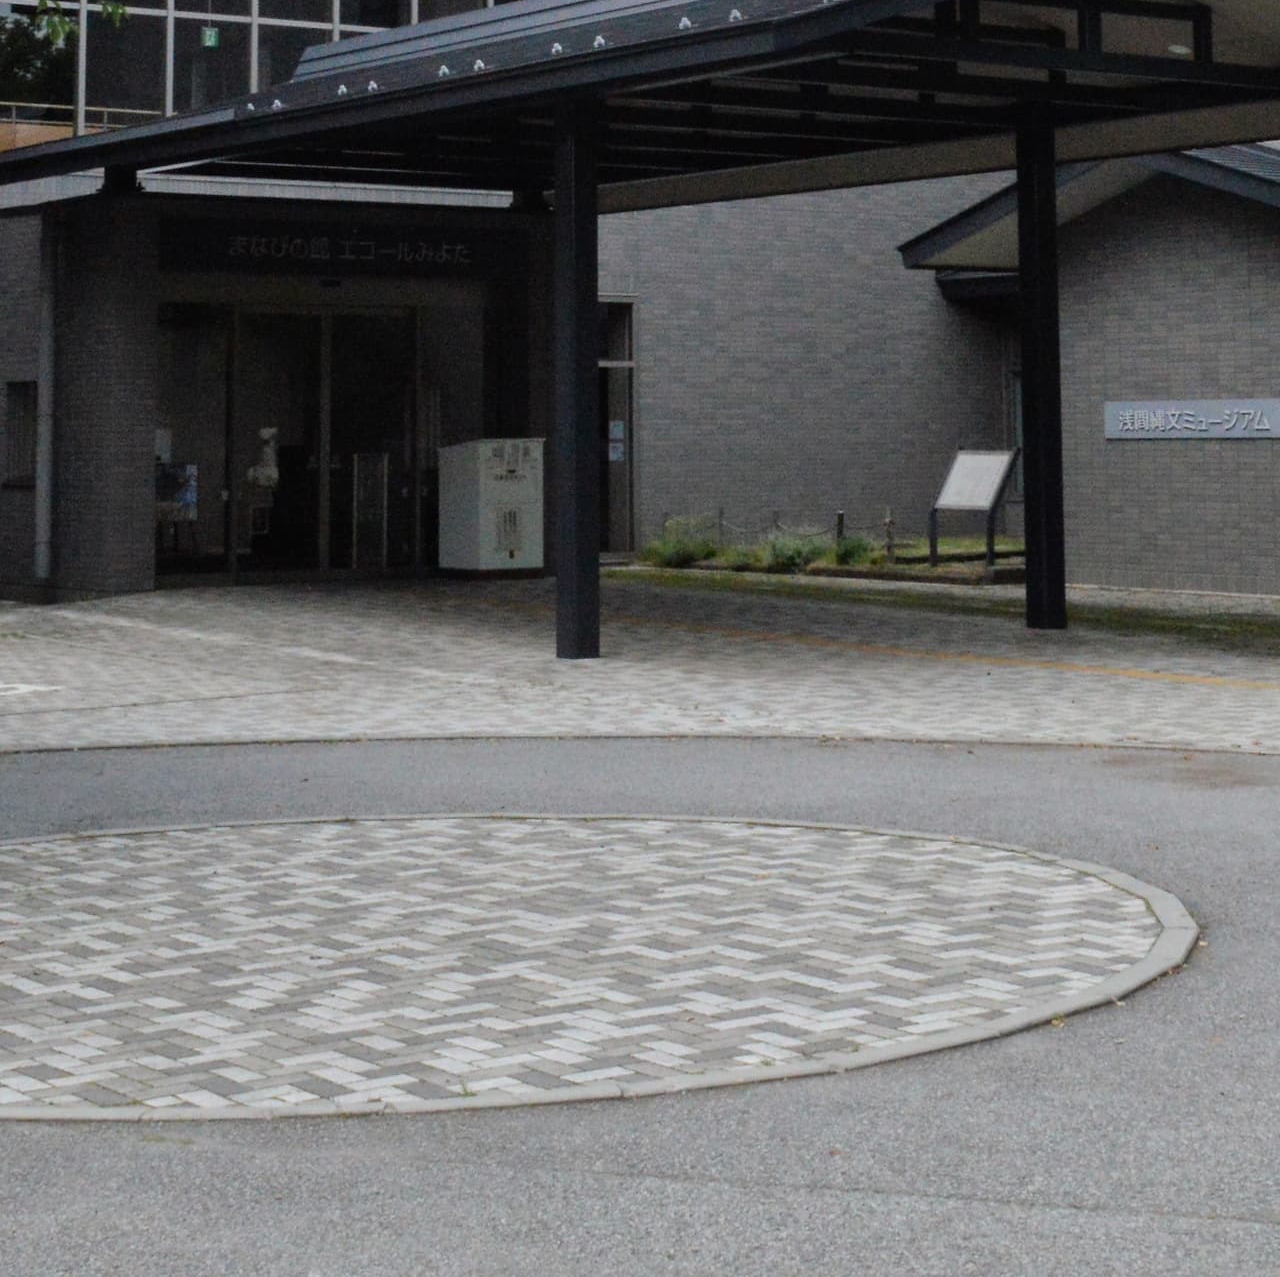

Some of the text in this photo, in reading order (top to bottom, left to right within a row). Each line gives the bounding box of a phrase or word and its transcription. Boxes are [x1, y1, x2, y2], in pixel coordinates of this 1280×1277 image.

[228, 234, 473, 265] まなびの館 エコールみよた
[1118, 408, 1271, 432] 浅間縄文ミュージアム
